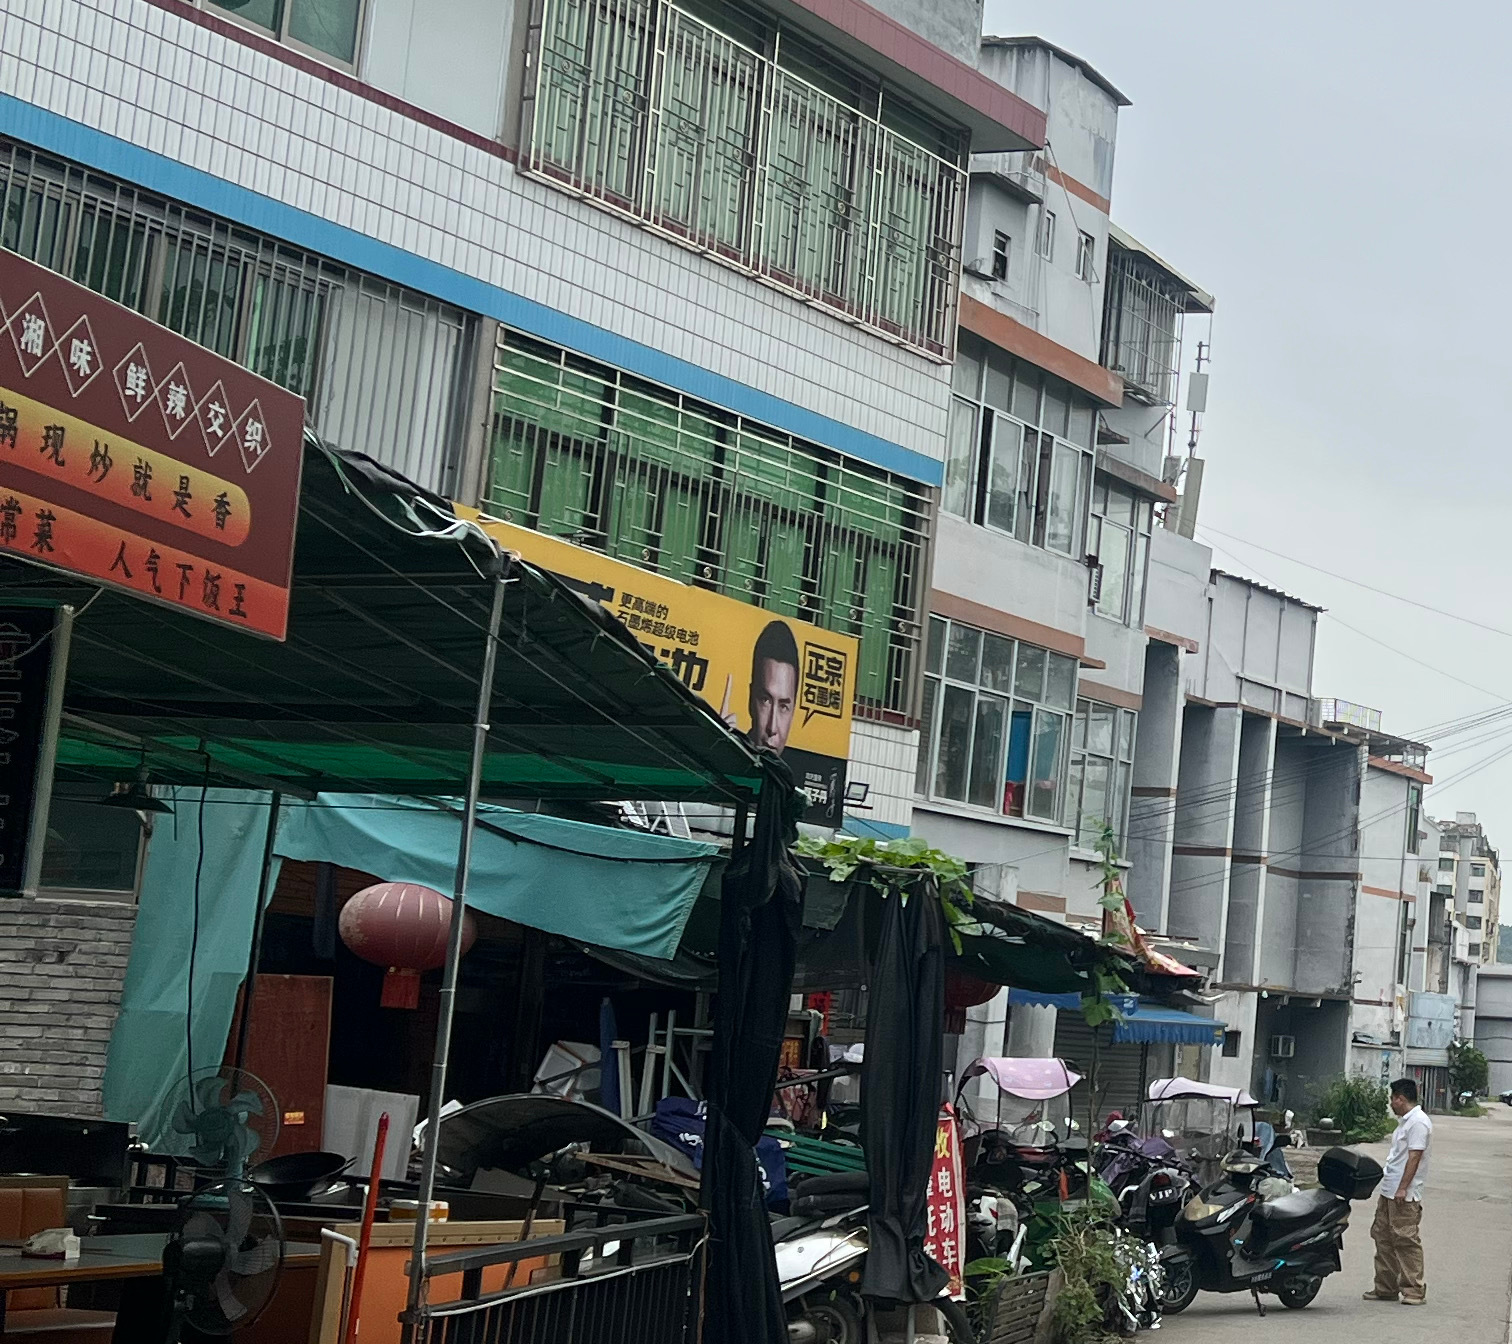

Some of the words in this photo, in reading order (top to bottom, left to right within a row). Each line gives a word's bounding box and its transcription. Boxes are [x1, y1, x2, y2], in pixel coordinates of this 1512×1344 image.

[20, 312, 94, 378] 湘味
[124, 362, 264, 456] 鲜辣交织
[108, 540, 248, 618] 人气下饭王
[618, 592, 670, 621] 更高端的
[616, 610, 700, 647] 石墨烯超级电池
[805, 650, 843, 688] 正宗
[803, 683, 841, 711] 石墨烯
[1149, 1188, 1173, 1201] VIP
[937, 1167, 958, 1271] 电动车
